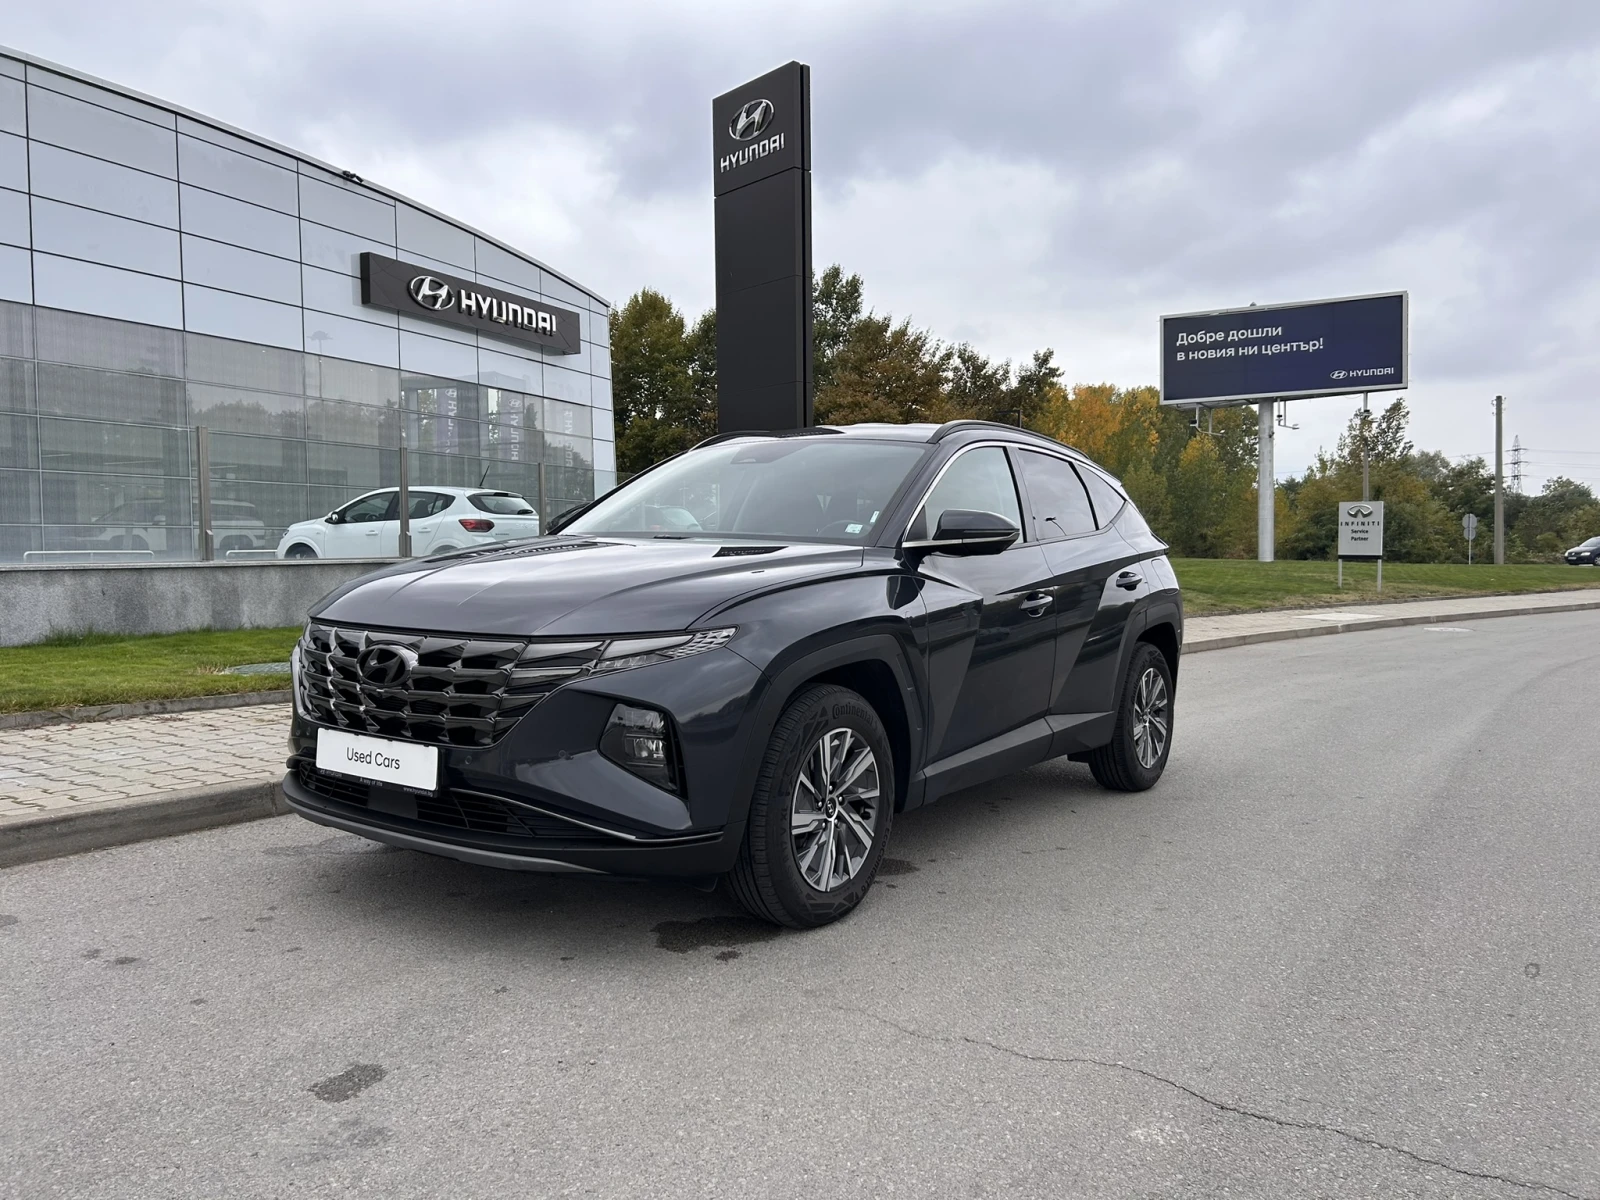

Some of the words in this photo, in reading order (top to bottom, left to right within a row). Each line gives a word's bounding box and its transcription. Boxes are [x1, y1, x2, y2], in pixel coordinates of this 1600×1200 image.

[720, 132, 784, 173] HYUNDAI
[459, 289, 558, 335] HYUNDAI
[1176, 330, 1225, 346] Добре
[1228, 326, 1282, 342] дошли
[1176, 351, 1185, 361] в
[1189, 347, 1235, 360] новия
[1238, 345, 1258, 356] ни
[1261, 338, 1324, 355] център!
[1349, 367, 1394, 377] HYUNDAI
[831, 702, 874, 727] Continental
[346, 747, 372, 765] Used
[374, 752, 401, 770] Cars
